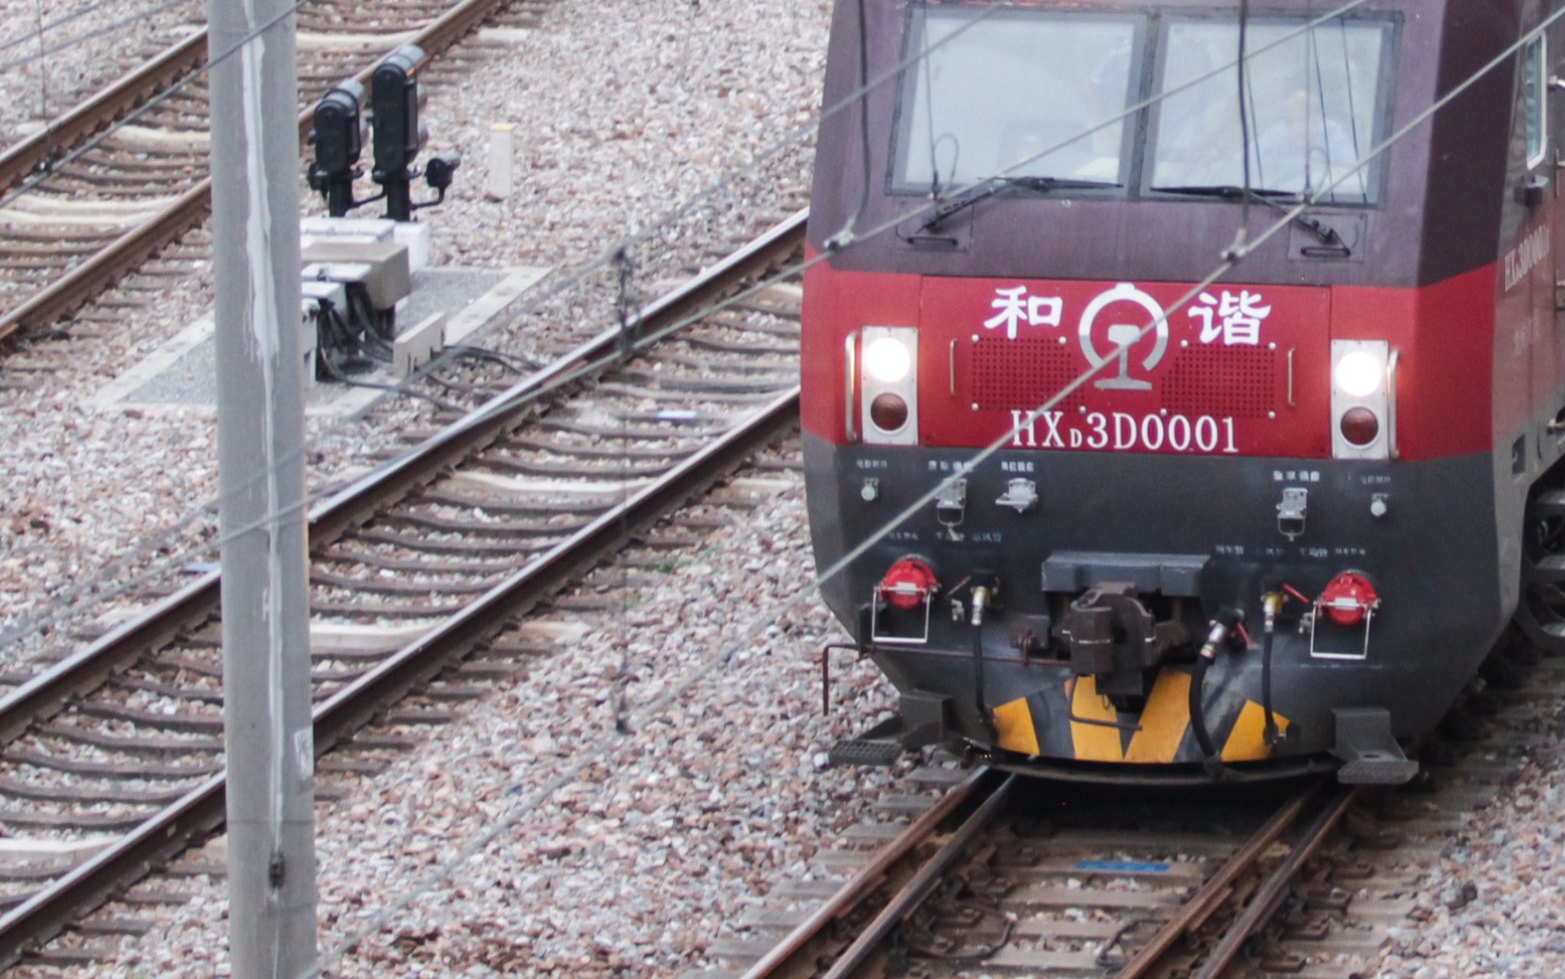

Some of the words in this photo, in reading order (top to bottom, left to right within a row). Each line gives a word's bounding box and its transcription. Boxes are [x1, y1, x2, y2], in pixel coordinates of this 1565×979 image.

[984, 285, 1063, 340] 和
[1188, 290, 1272, 346] 谐
[1010, 409, 1239, 453] HXD3D0001
